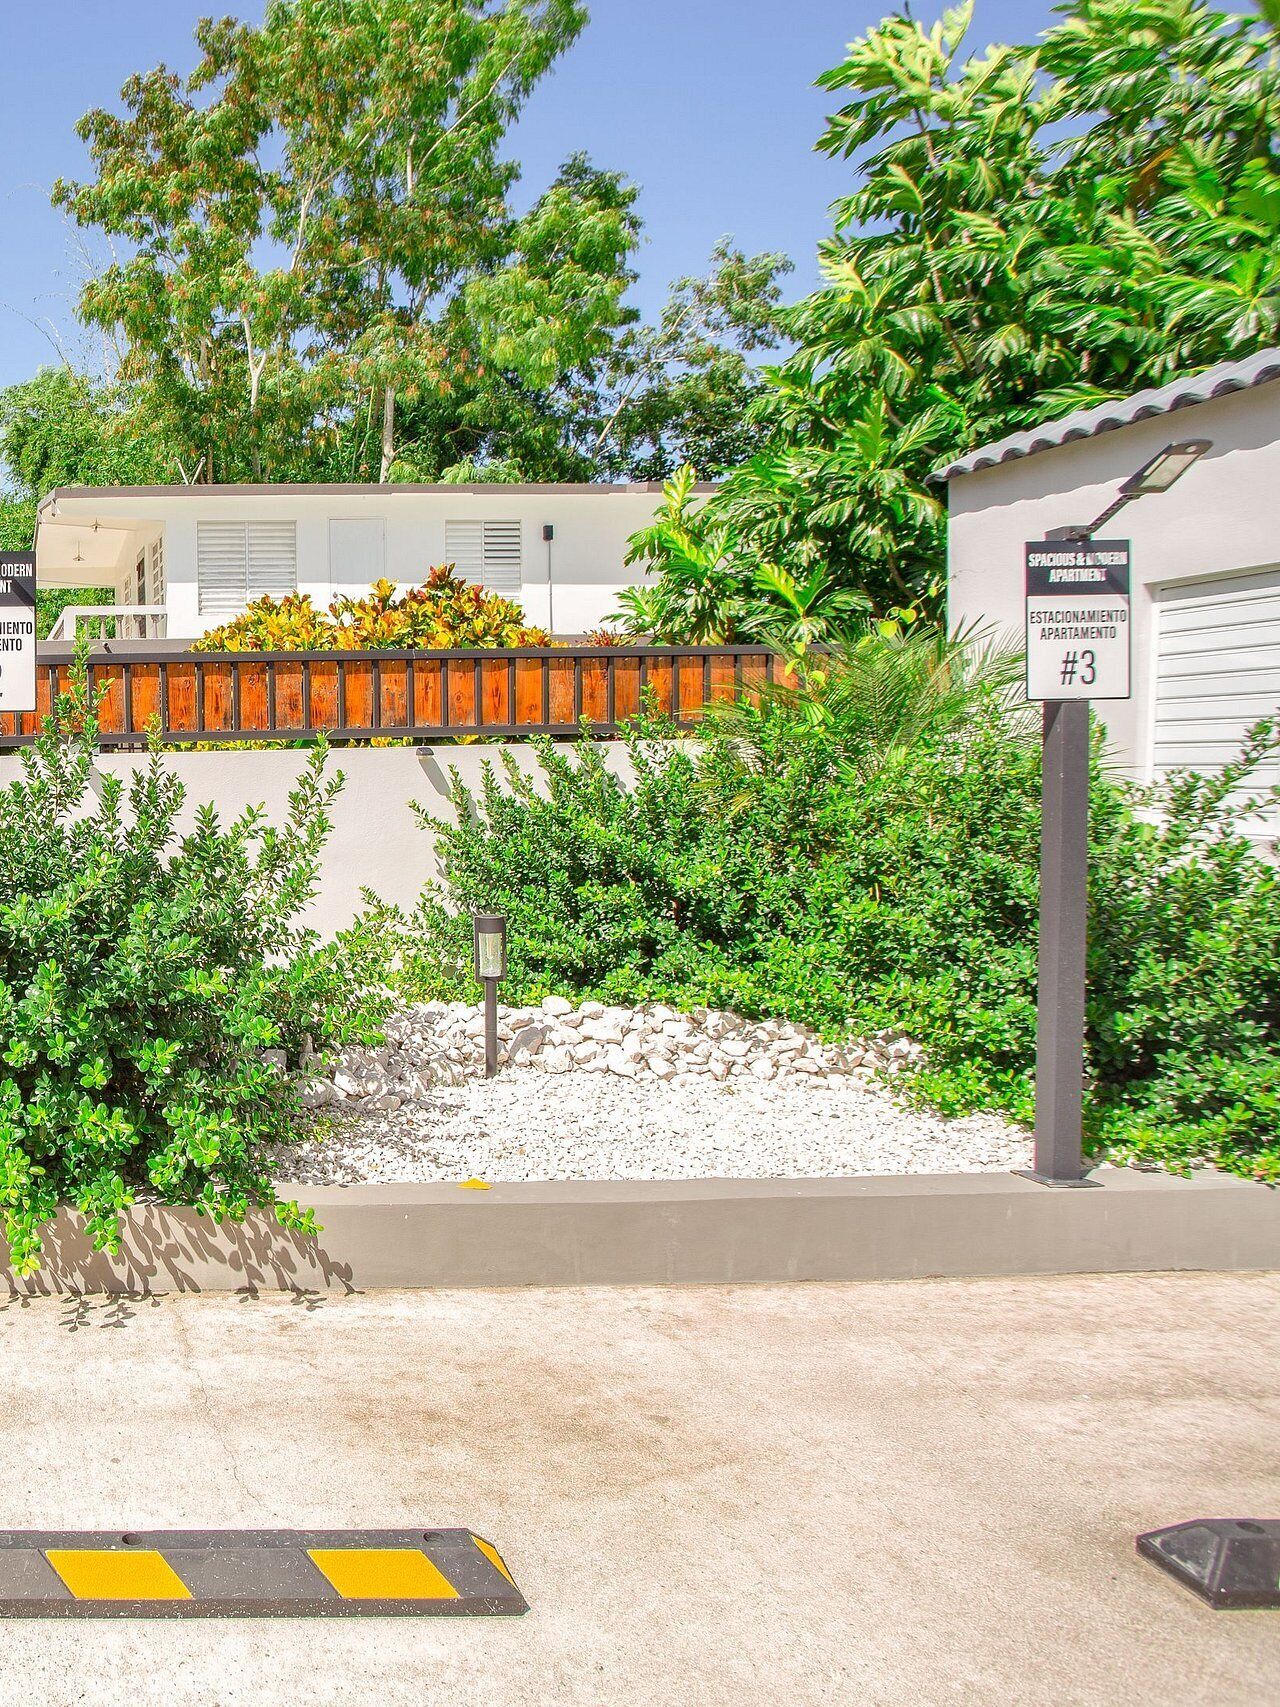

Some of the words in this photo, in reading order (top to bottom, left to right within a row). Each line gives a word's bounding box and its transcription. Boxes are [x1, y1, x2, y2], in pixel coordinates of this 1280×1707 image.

[1029, 553, 1075, 566] SPACIOUS
[1077, 553, 1085, 566] &
[1086, 552, 1128, 565] MODERN
[1049, 569, 1107, 582] APARTMENT
[1030, 610, 1127, 624] ESTACIONAMIENTO
[1040, 627, 1116, 640] APARTAMENTO
[1061, 650, 1096, 685] #3
